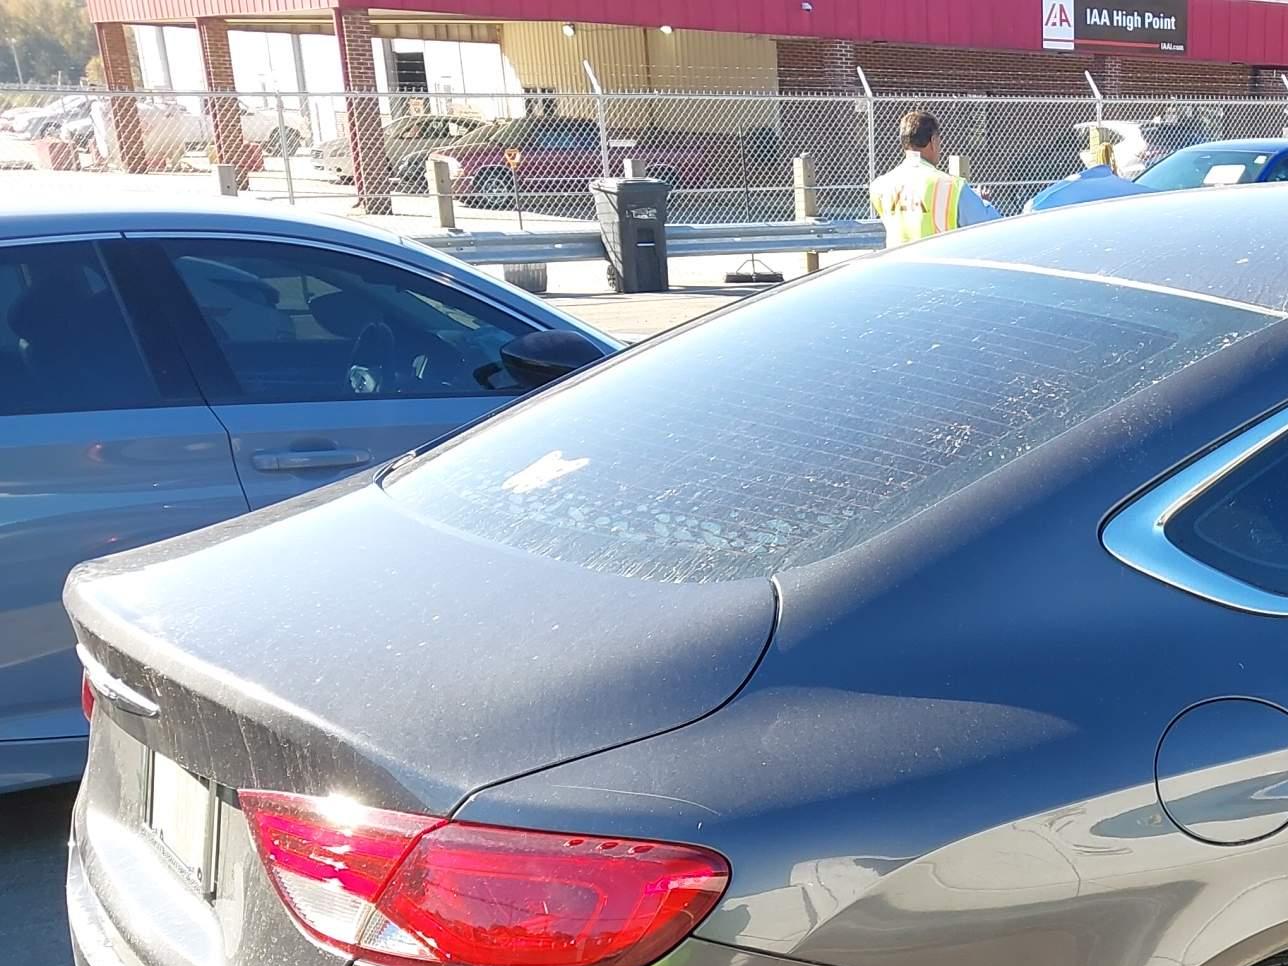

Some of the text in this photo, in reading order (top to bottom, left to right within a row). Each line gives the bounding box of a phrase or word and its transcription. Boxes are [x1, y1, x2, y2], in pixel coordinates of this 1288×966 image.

[1086, 8, 1176, 31] IAA High Point
